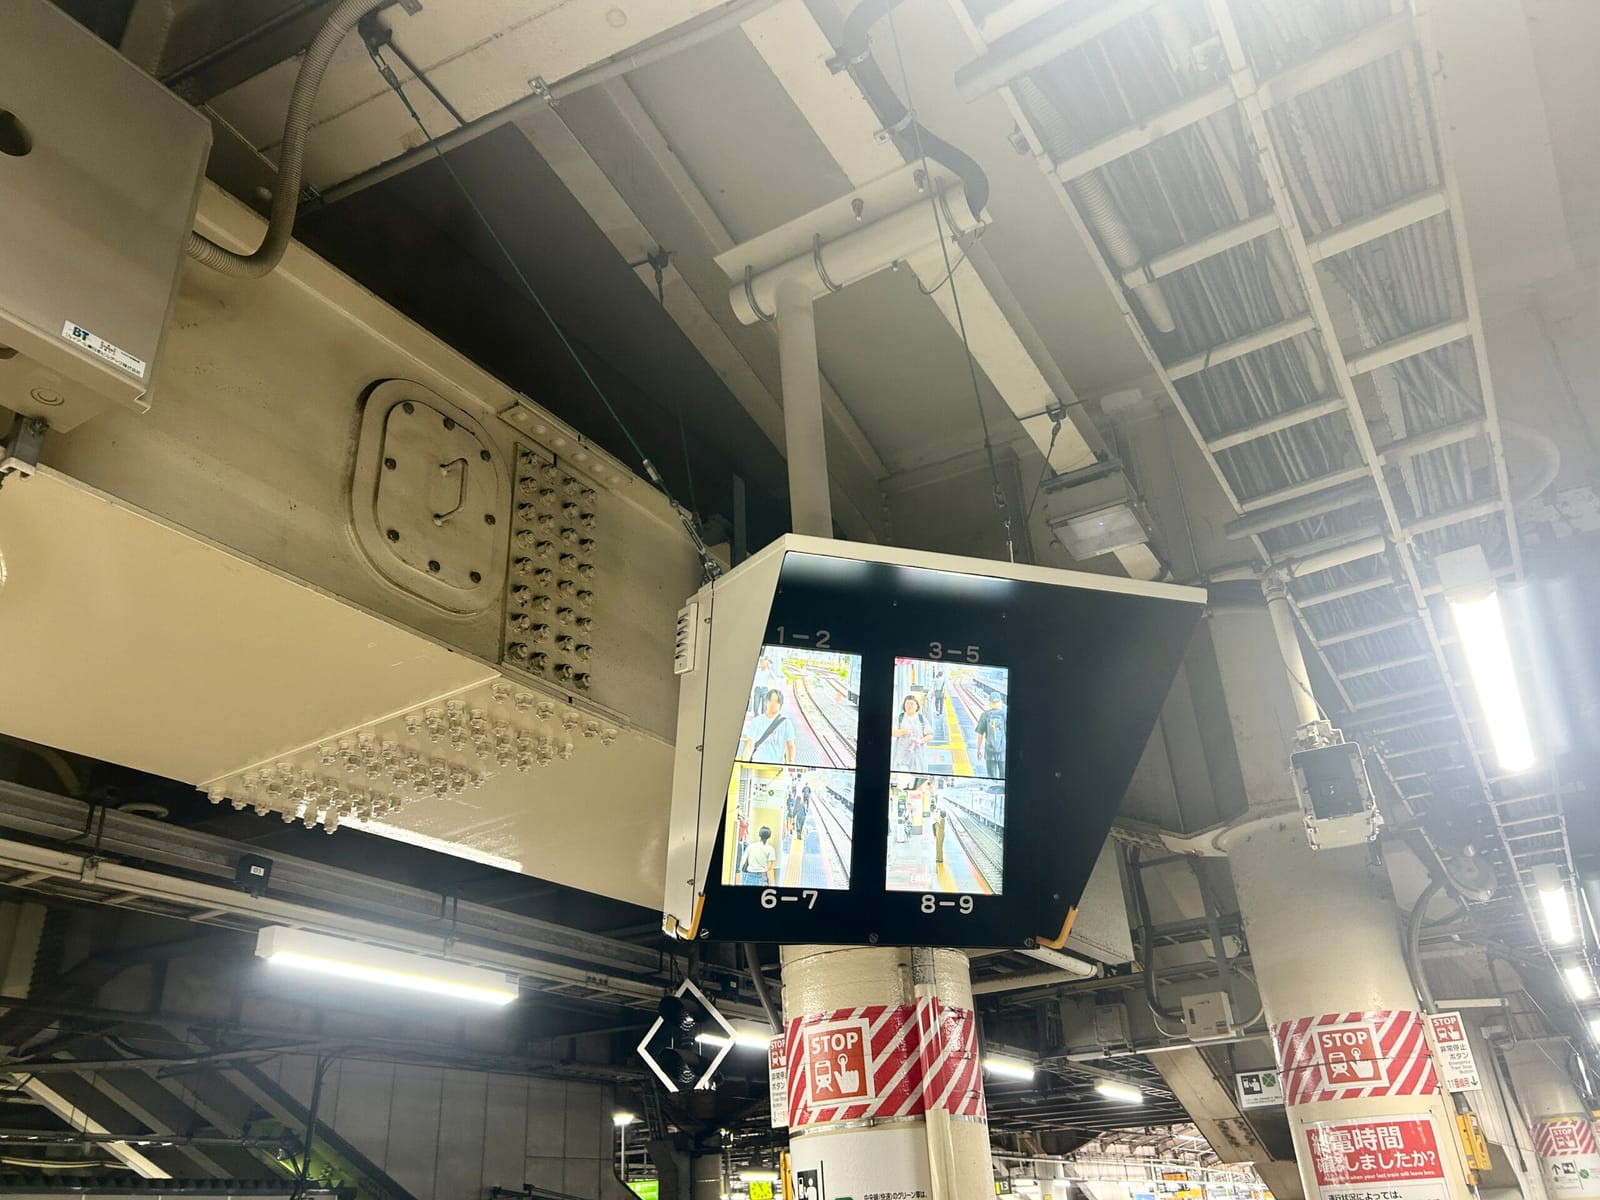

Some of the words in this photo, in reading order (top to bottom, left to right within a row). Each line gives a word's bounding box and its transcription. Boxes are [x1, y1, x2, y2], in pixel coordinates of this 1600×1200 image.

[73, 326, 89, 341] BT
[1433, 1017, 1457, 1026] STOP
[811, 1032, 858, 1054] STOP
[1322, 1032, 1367, 1048] STOP
[1553, 1128, 1573, 1136] STOP
[1000, 1181, 1009, 1191] 13
